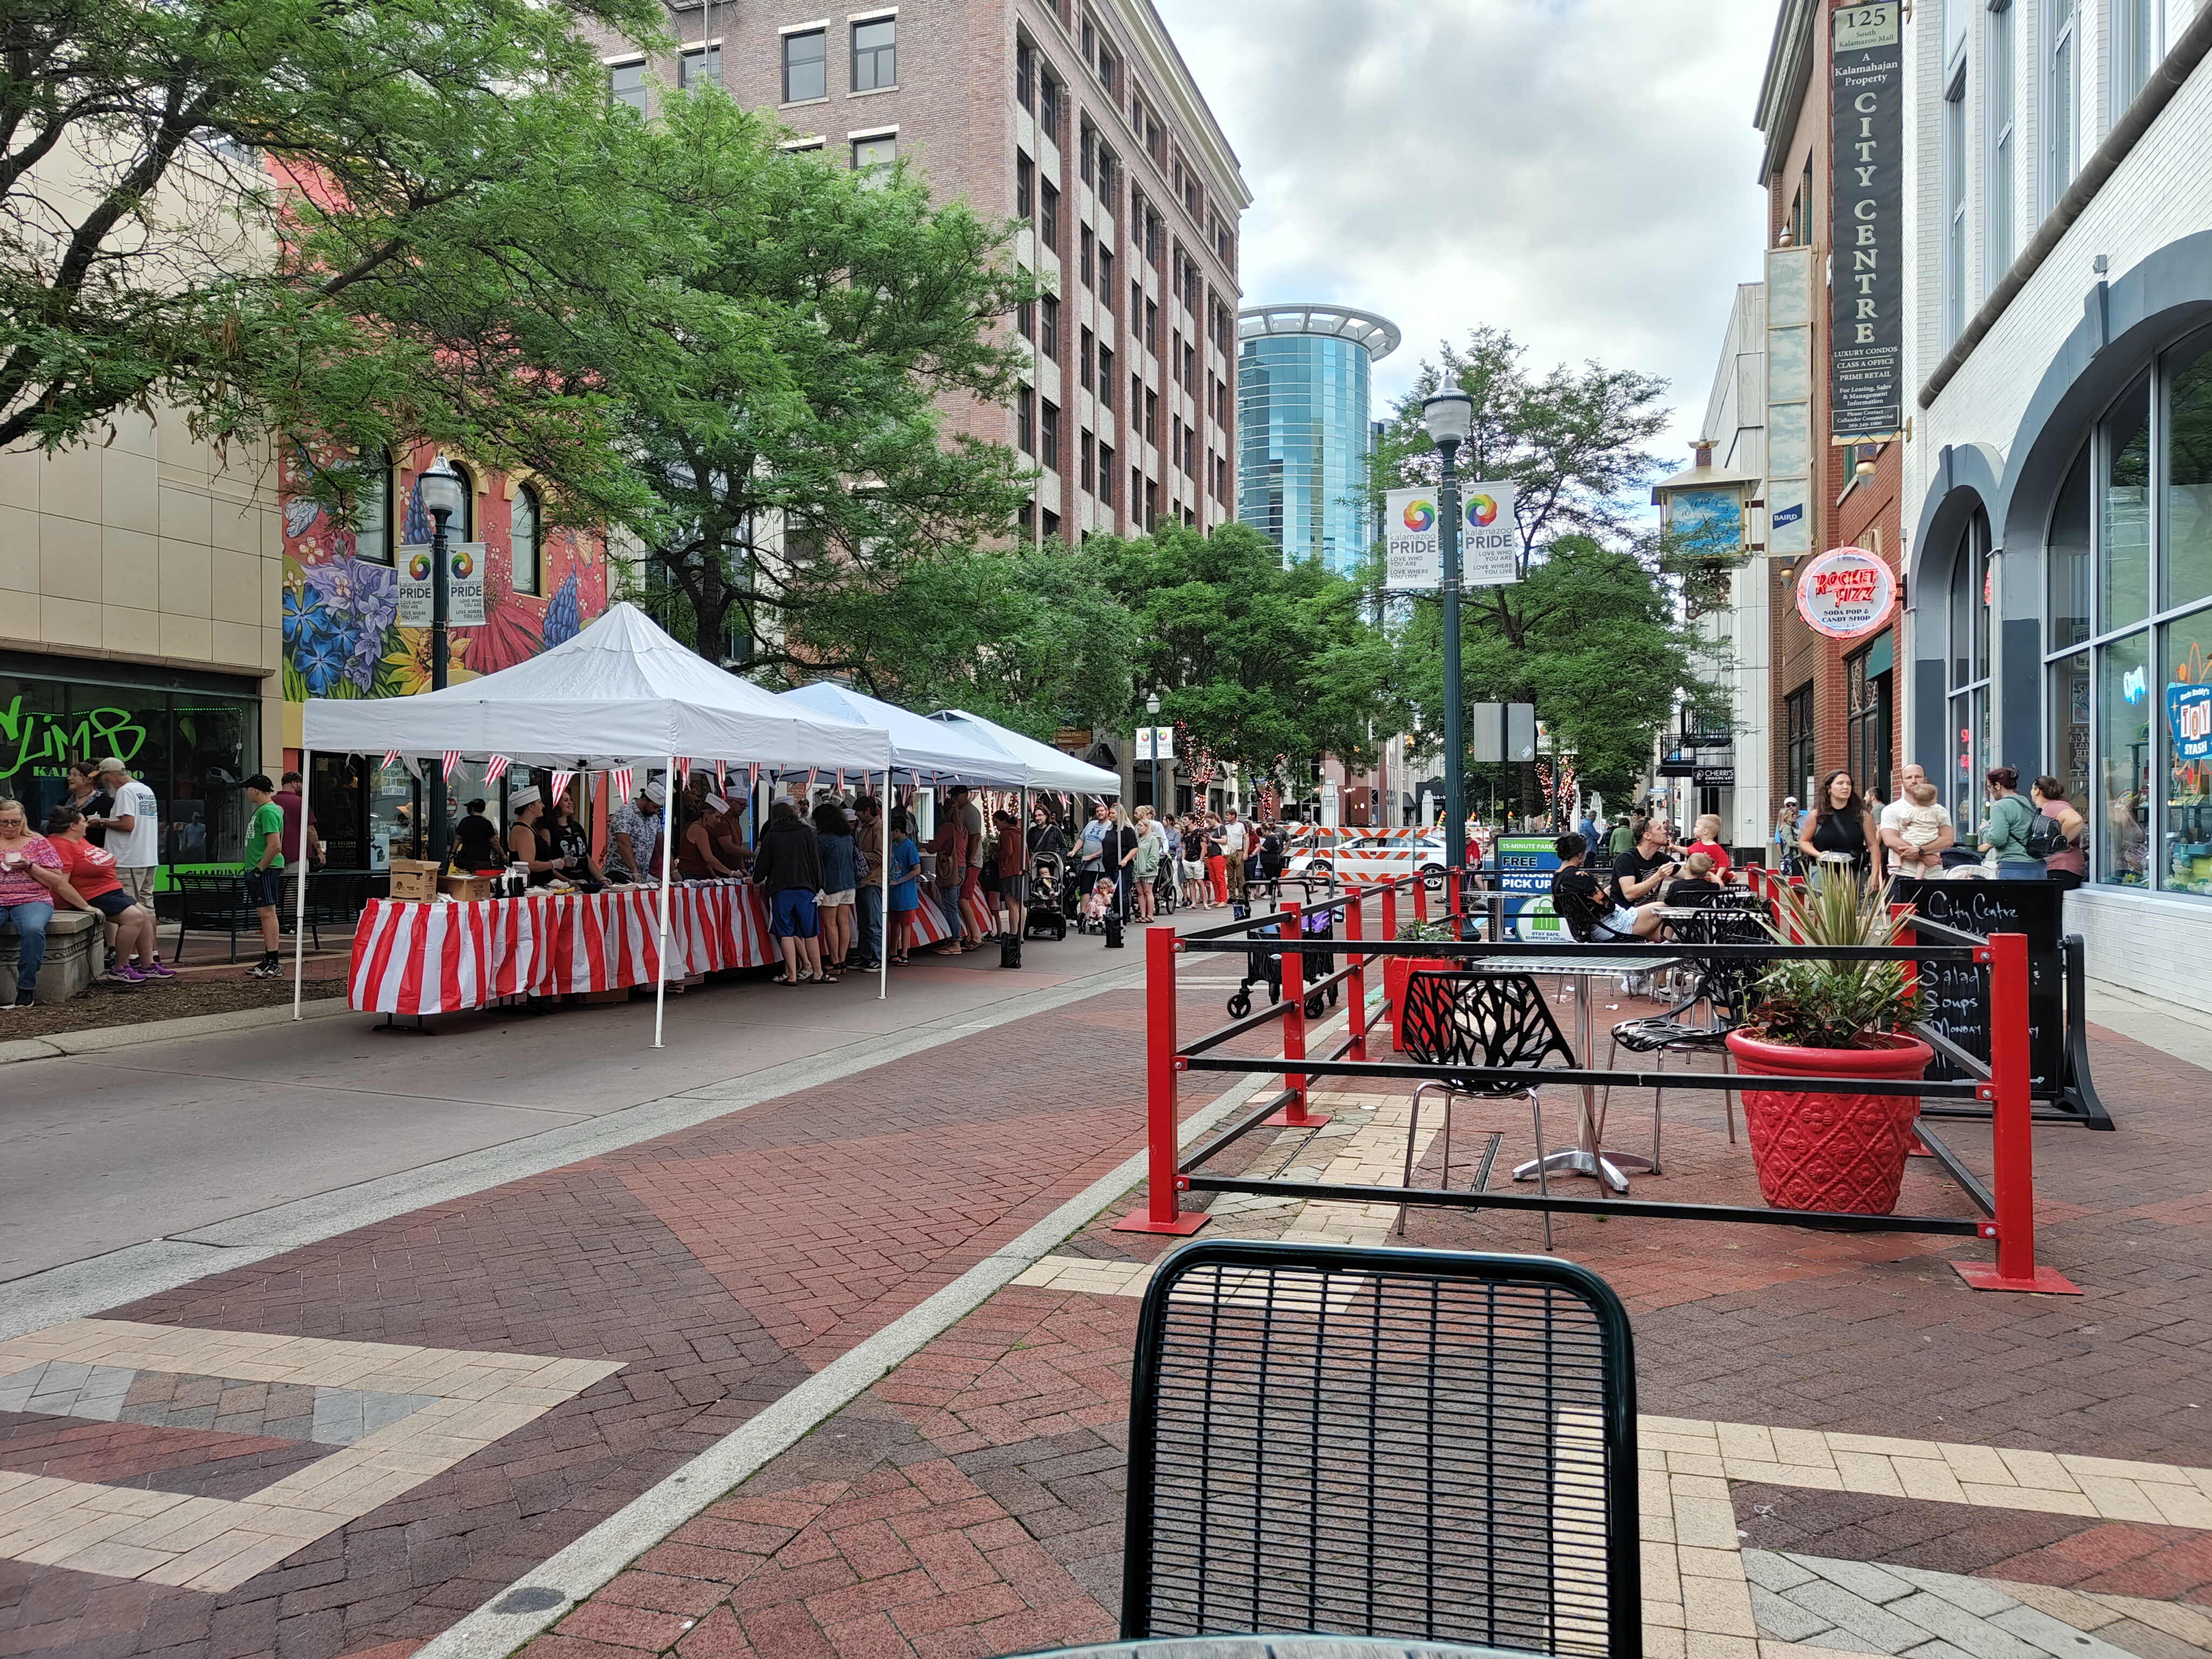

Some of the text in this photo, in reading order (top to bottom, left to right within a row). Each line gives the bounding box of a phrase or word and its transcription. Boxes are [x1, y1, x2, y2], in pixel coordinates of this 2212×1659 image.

[1847, 8, 1886, 28] 125
[1856, 29, 1876, 38] South
[1839, 34, 1894, 48] Kalamazoo Mall
[1862, 52, 1870, 62] A
[1835, 61, 1898, 77] Kalamahajan
[1845, 73, 1888, 87] Property
[1854, 92, 1877, 186] CITY
[1853, 199, 1879, 344] CENTRE
[1834, 346, 1898, 358] LUXURY CONDOS
[1867, 358, 1894, 366] OFFICE
[1864, 371, 1891, 379] RETAIL
[1849, 391, 1888, 399] Management
[1862, 413, 1893, 421] Commercial
[1773, 513, 1797, 522] BAIRD
[1390, 532, 1436, 541] kalamazoo
[1465, 528, 1512, 536] kalamazoo
[1390, 541, 1436, 554] PRIDE
[1466, 535, 1512, 550] PRIDE
[1812, 569, 1879, 595] ROCKET
[400, 588, 431, 598] PRIDE
[451, 586, 482, 597] PRIDE
[1829, 586, 1876, 608] FIZZ
[2191, 688, 2210, 696] Buddy's
[2181, 701, 2210, 739] TOY
[2184, 740, 2208, 755] STASH
[1502, 856, 1537, 867] FREE
[1502, 879, 1552, 889] PICK UP
[1928, 891, 1972, 932] City
[1973, 893, 2019, 921] Centre
[1919, 961, 1980, 993] Salad
[1924, 990, 1979, 1016] Soups
